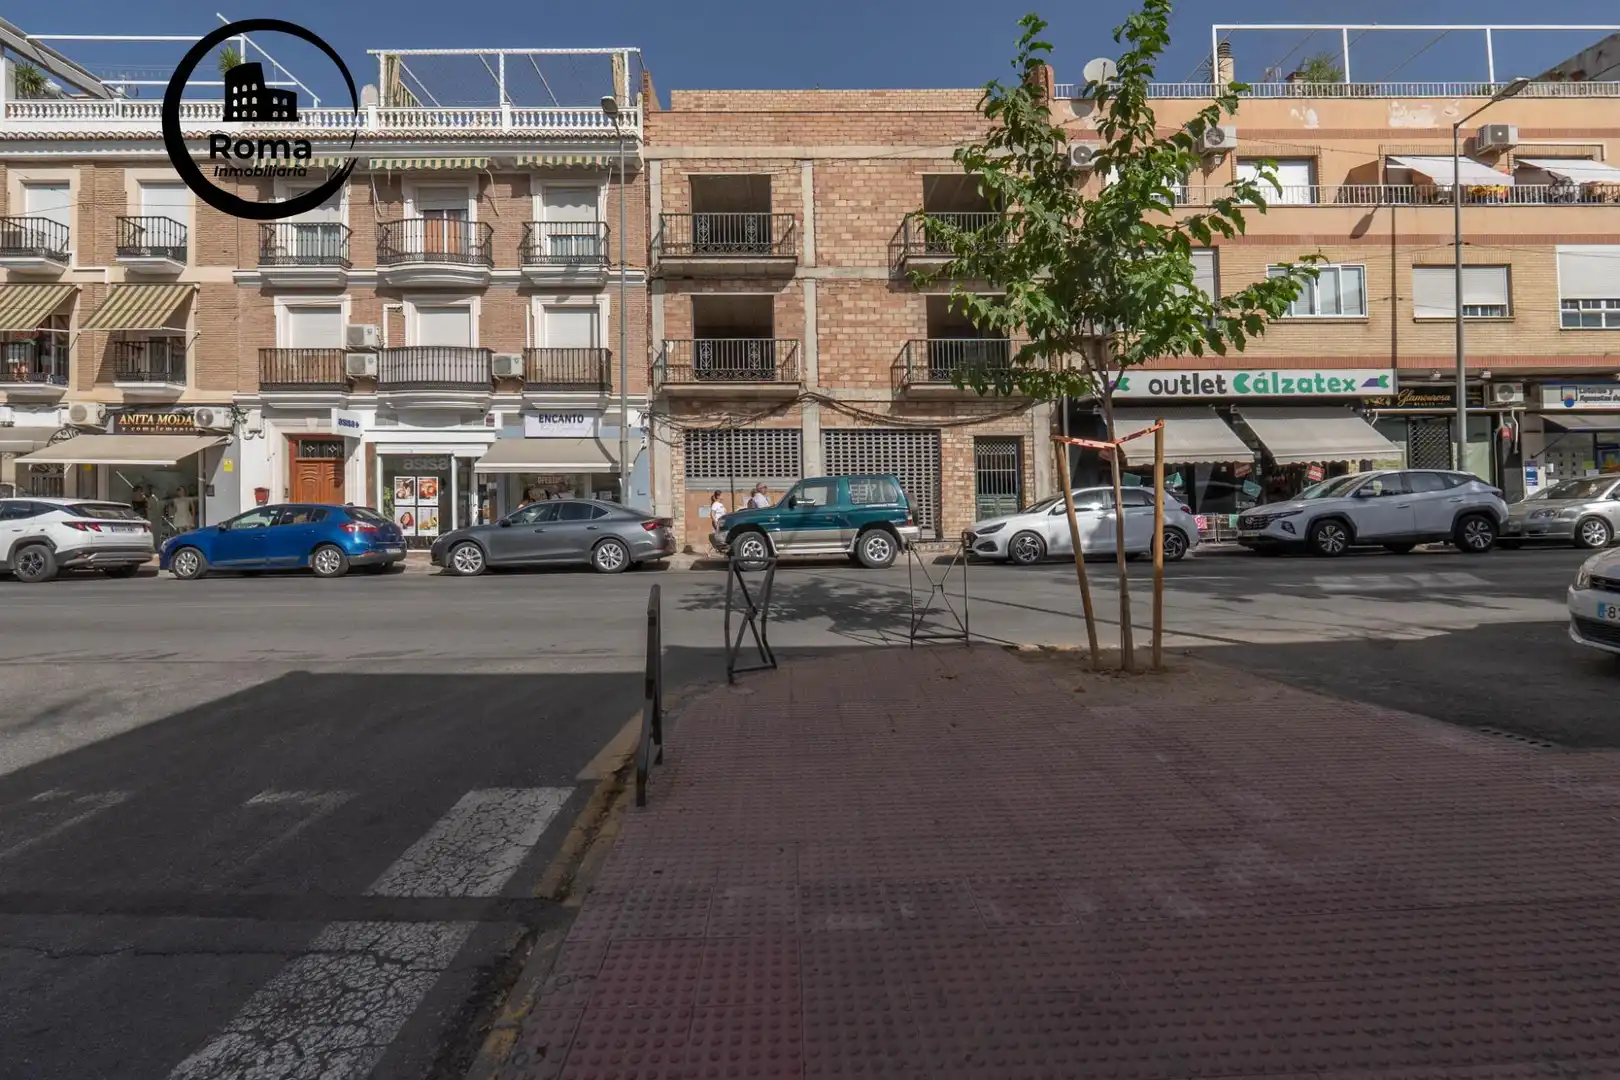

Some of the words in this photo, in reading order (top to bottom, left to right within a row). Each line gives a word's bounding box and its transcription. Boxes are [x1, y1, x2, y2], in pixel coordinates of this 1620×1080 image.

[1149, 374, 1227, 395] outlet
[119, 414, 155, 425] ANITA
[538, 414, 584, 424] ENCANTO
[403, 457, 449, 471] asisa
